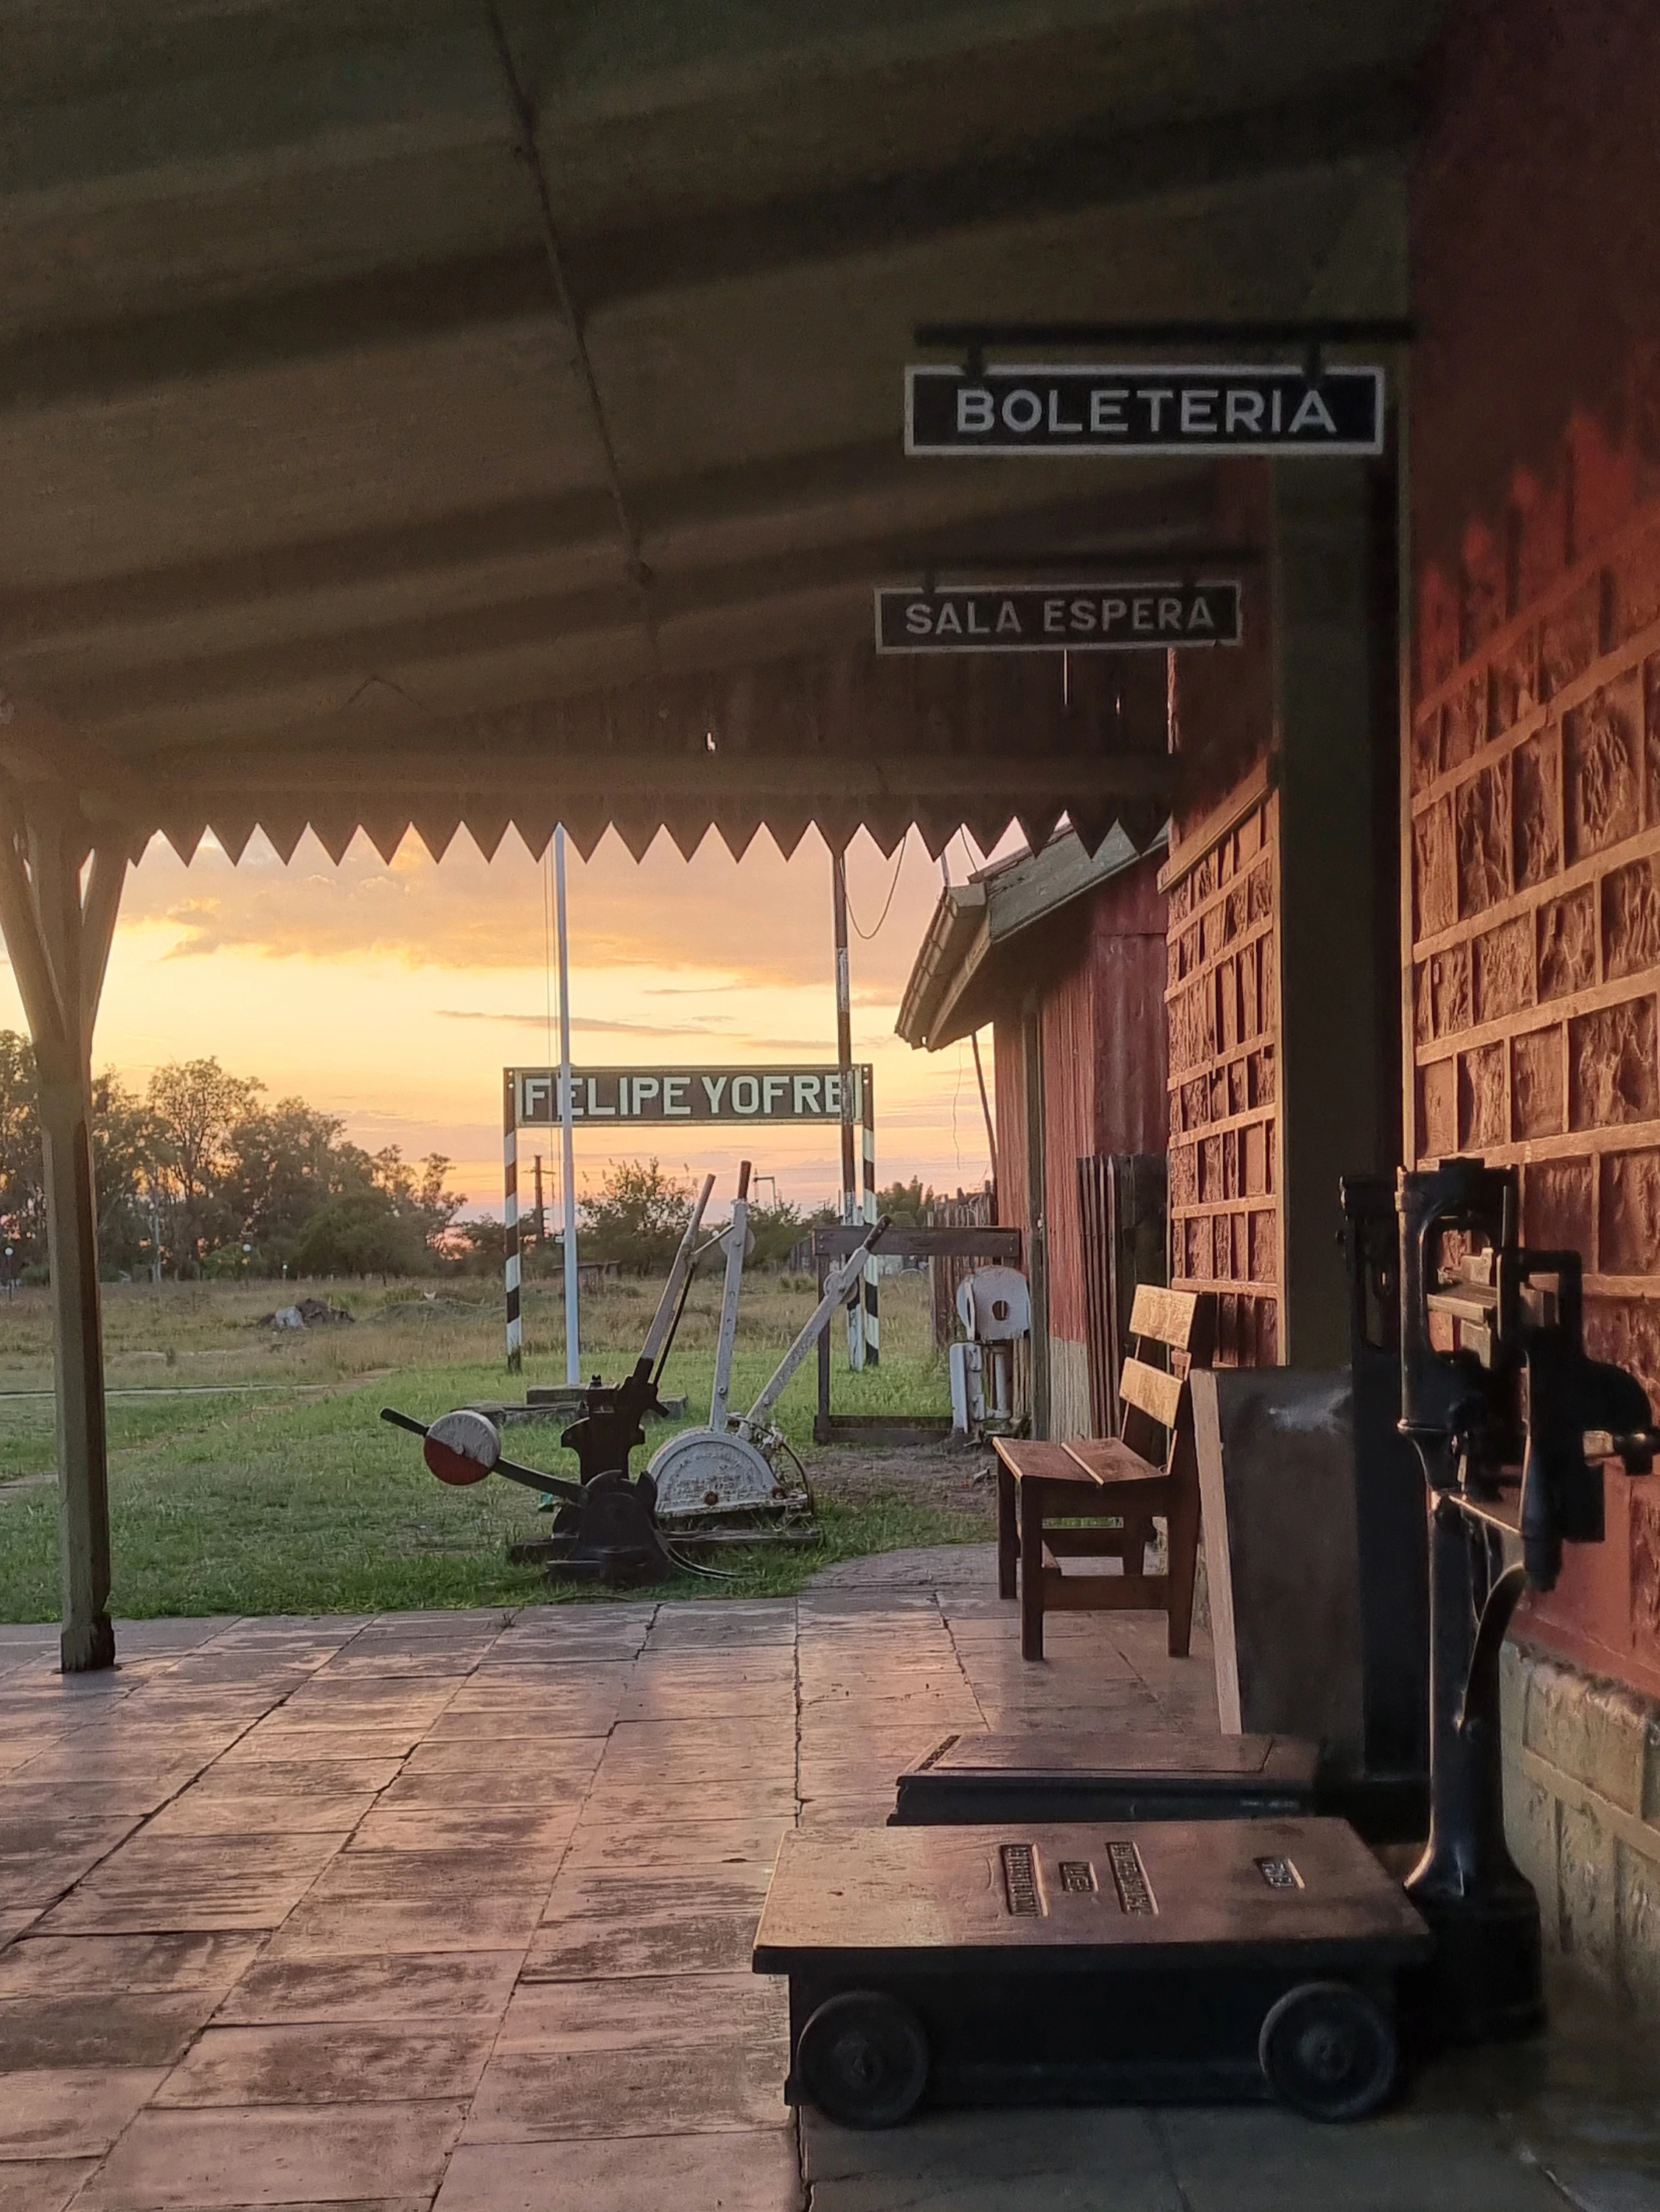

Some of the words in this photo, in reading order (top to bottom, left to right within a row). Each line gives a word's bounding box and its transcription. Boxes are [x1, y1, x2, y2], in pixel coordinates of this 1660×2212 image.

[958, 389, 1337, 433] BOLETERIA
[906, 601, 1022, 635] SALA
[1044, 597, 1215, 632] ESPERA
[526, 1076, 691, 1116] FELIPE
